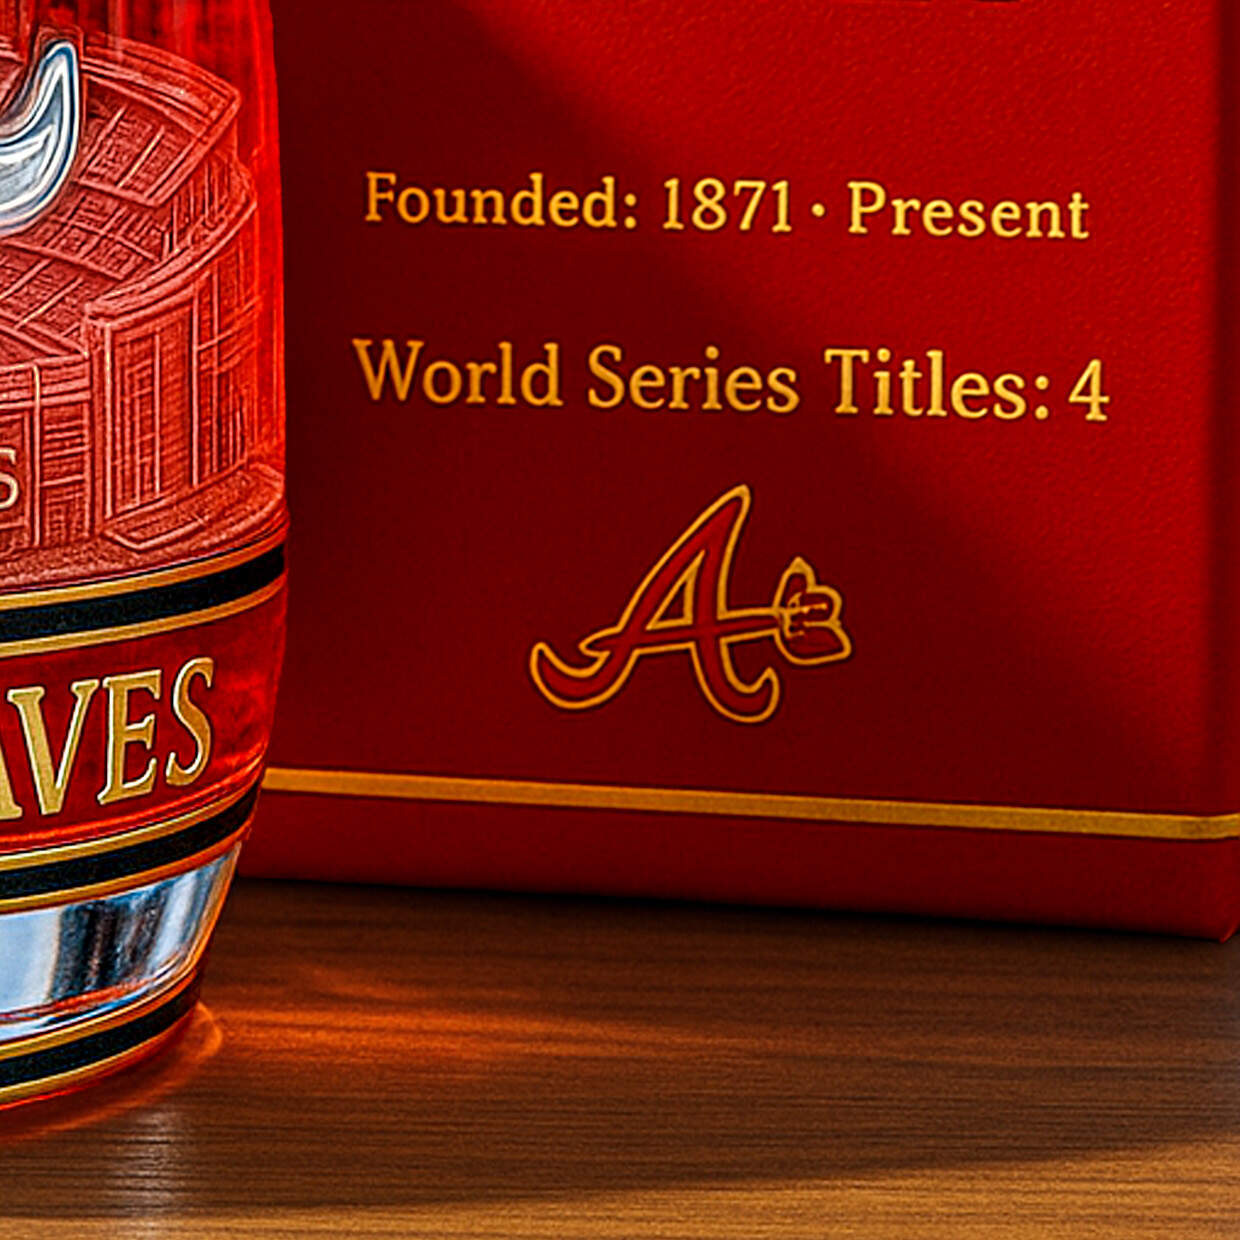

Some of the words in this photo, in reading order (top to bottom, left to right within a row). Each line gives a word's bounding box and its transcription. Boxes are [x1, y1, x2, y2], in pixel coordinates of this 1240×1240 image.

[365, 171, 639, 230] Founded:
[662, 177, 793, 232] 1871
[847, 180, 1090, 240] Present
[352, 338, 564, 408] World
[587, 344, 800, 415] Series
[824, 347, 1050, 421] Titles:
[1068, 359, 1111, 422] 4
